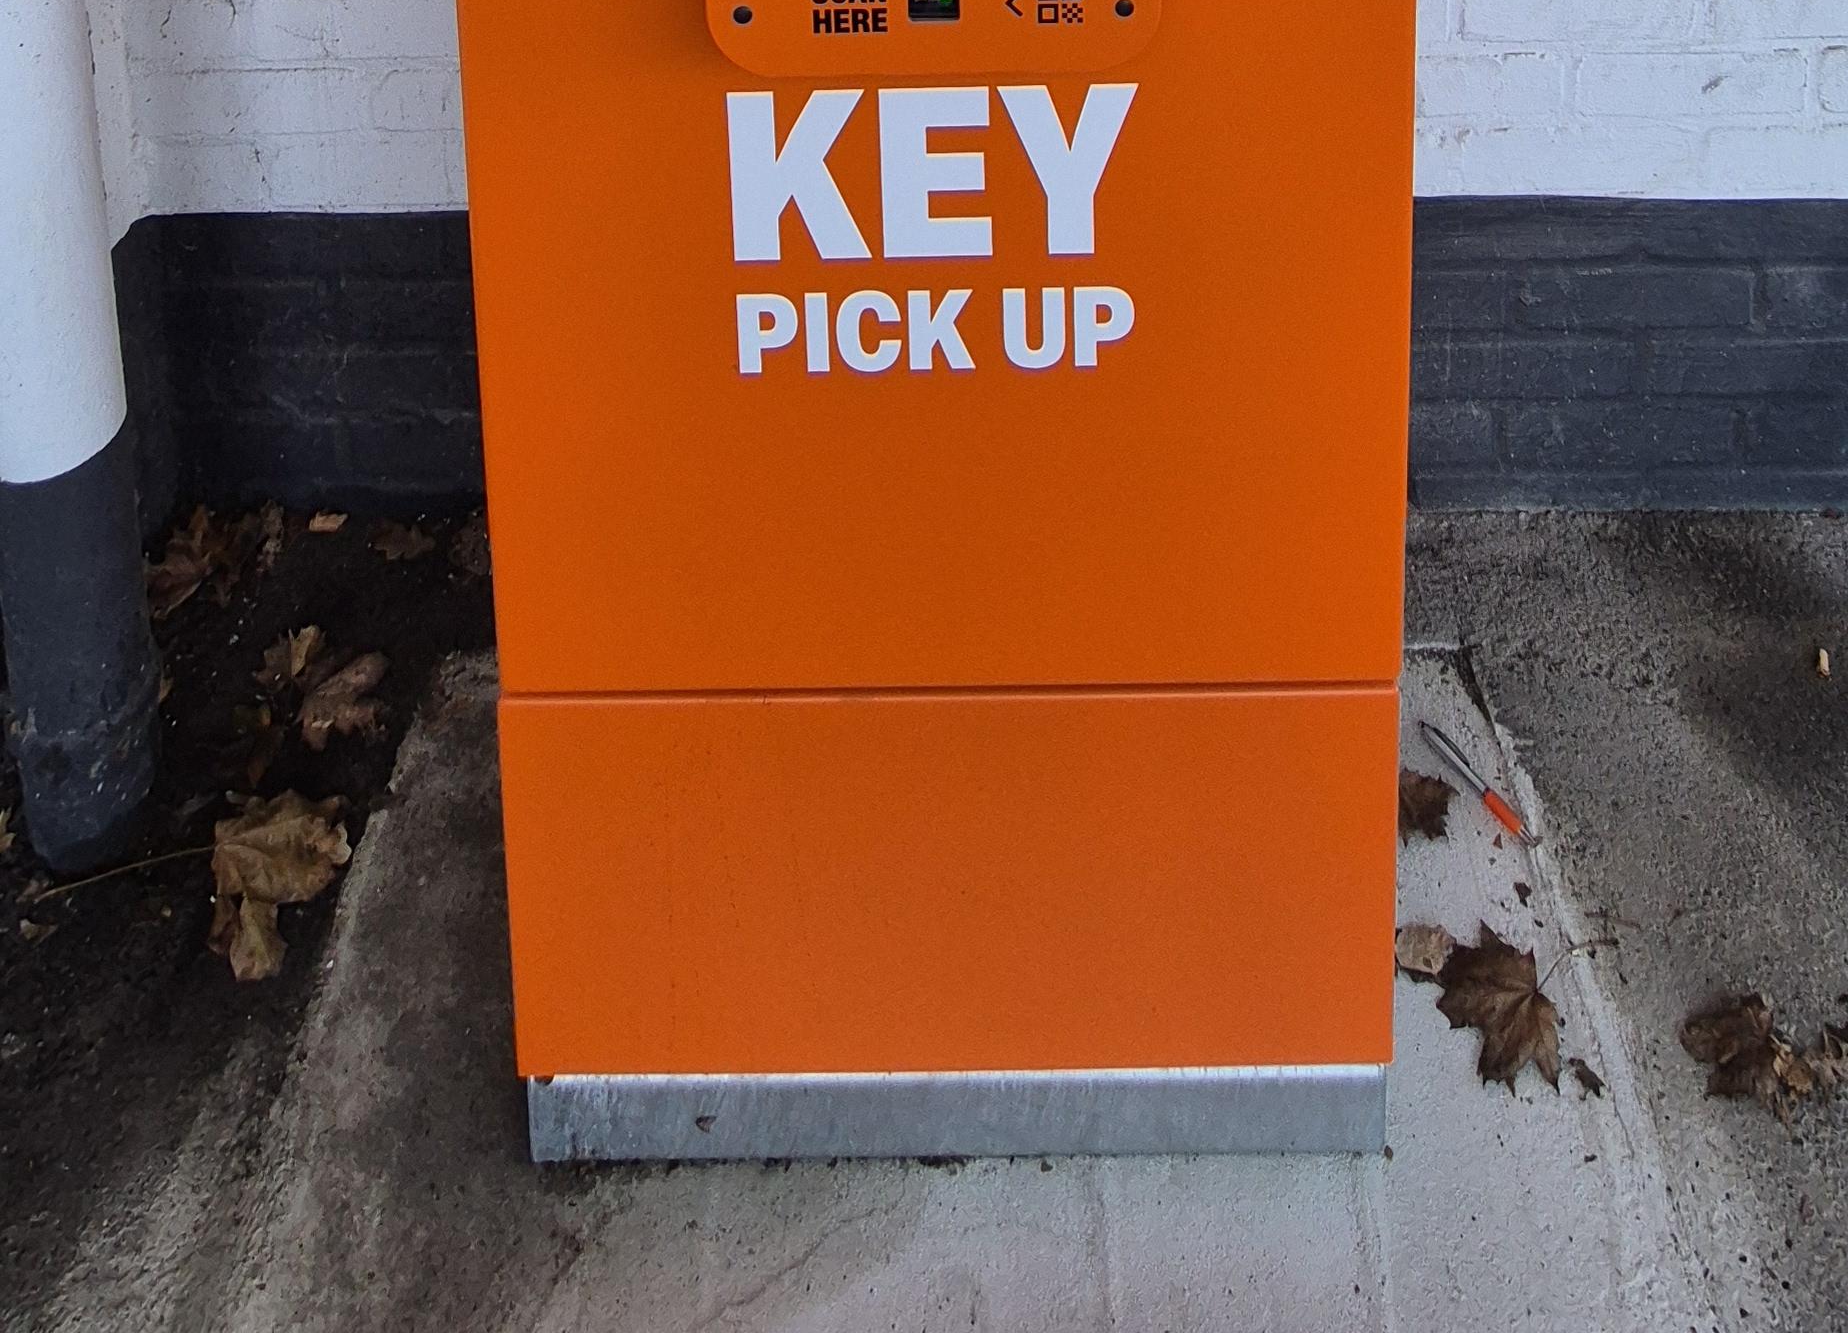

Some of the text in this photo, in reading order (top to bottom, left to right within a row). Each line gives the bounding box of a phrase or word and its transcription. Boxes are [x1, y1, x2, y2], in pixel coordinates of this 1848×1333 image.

[812, 8, 888, 34] HERE
[726, 83, 1139, 261] KEY
[736, 286, 1136, 374] PICK UP
